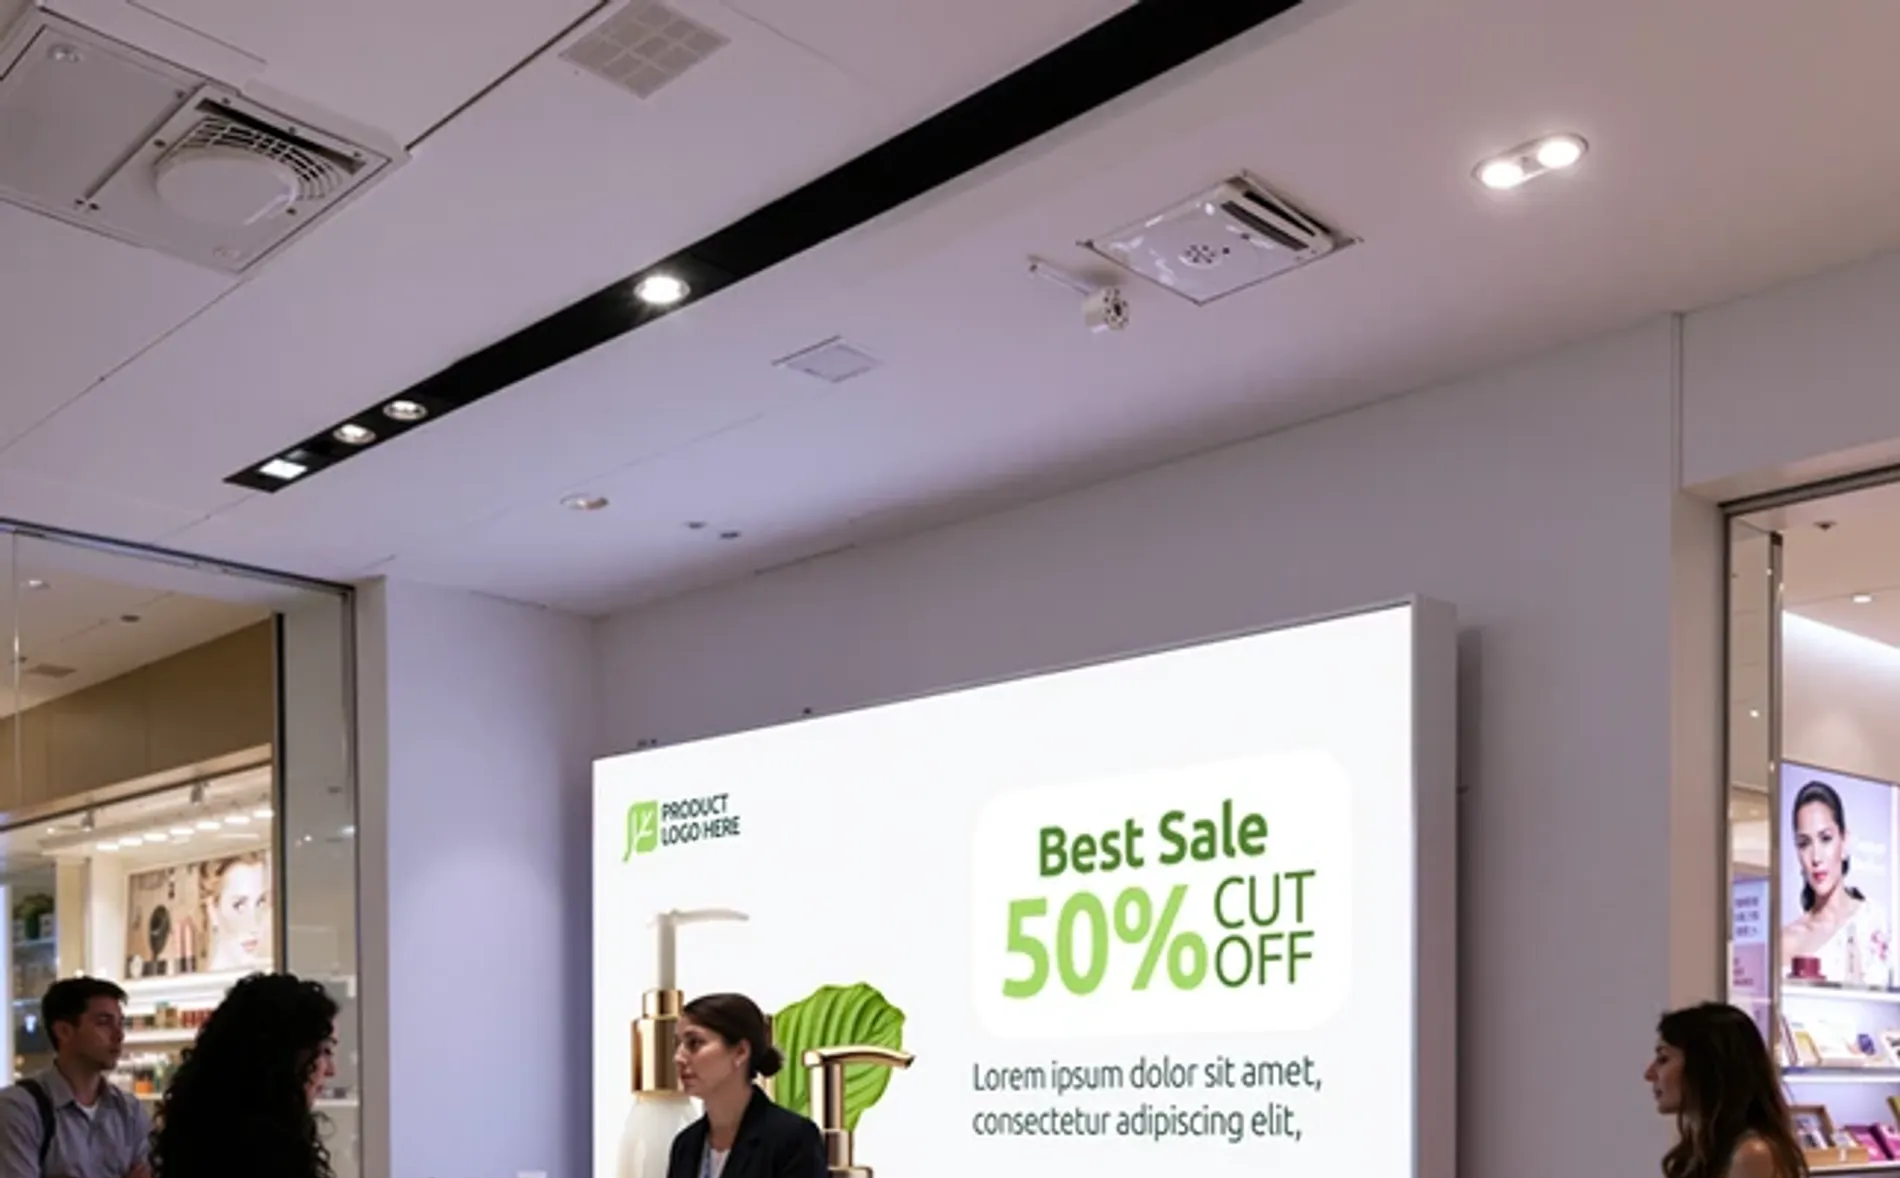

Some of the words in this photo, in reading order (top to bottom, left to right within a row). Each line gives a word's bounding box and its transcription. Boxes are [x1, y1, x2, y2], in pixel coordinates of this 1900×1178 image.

[662, 793, 729, 821] PRODUCT
[662, 822, 700, 846] LOGO
[703, 815, 741, 840] HERE
[1039, 825, 1144, 878] Best
[1158, 798, 1269, 865] Sale
[1214, 869, 1316, 930] CUT
[1002, 884, 1208, 999] 50%
[1214, 930, 1315, 988] OFF
[973, 1062, 1046, 1091] Lorem
[1051, 1060, 1123, 1096] ipsum
[1129, 1056, 1198, 1089] dolor
[1204, 1056, 1235, 1088] sit
[1241, 1055, 1322, 1092] amet,
[972, 1107, 1111, 1136] consectetur
[1116, 1103, 1245, 1144] adipiscing
[1251, 1103, 1302, 1141] elit,
